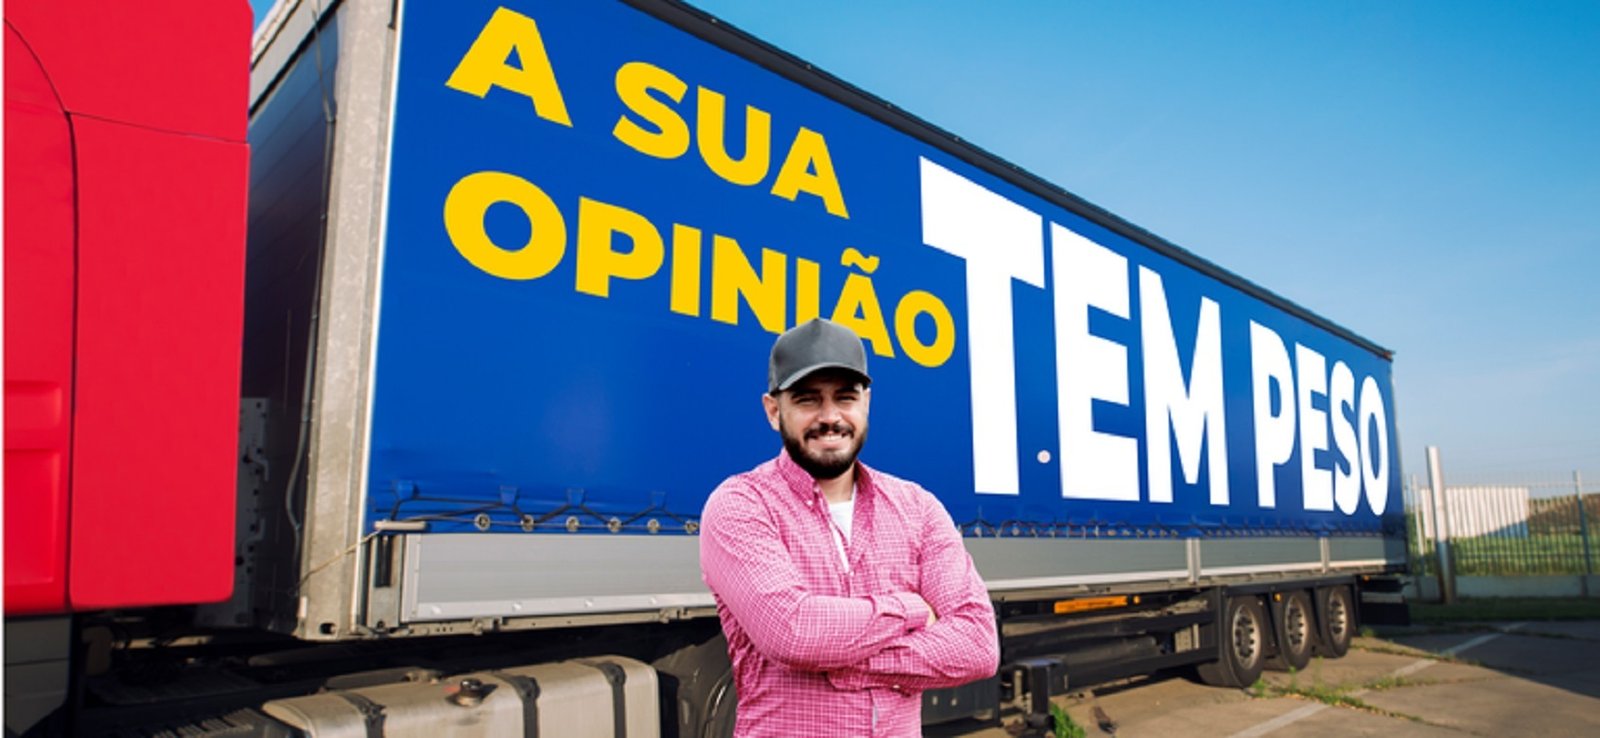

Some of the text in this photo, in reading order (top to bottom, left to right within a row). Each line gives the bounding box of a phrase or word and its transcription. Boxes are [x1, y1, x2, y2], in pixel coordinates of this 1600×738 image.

[447, 6, 849, 218] A SUA
[443, 171, 956, 367] OPINIÃO
[920, 156, 1389, 516] TEM PESO
